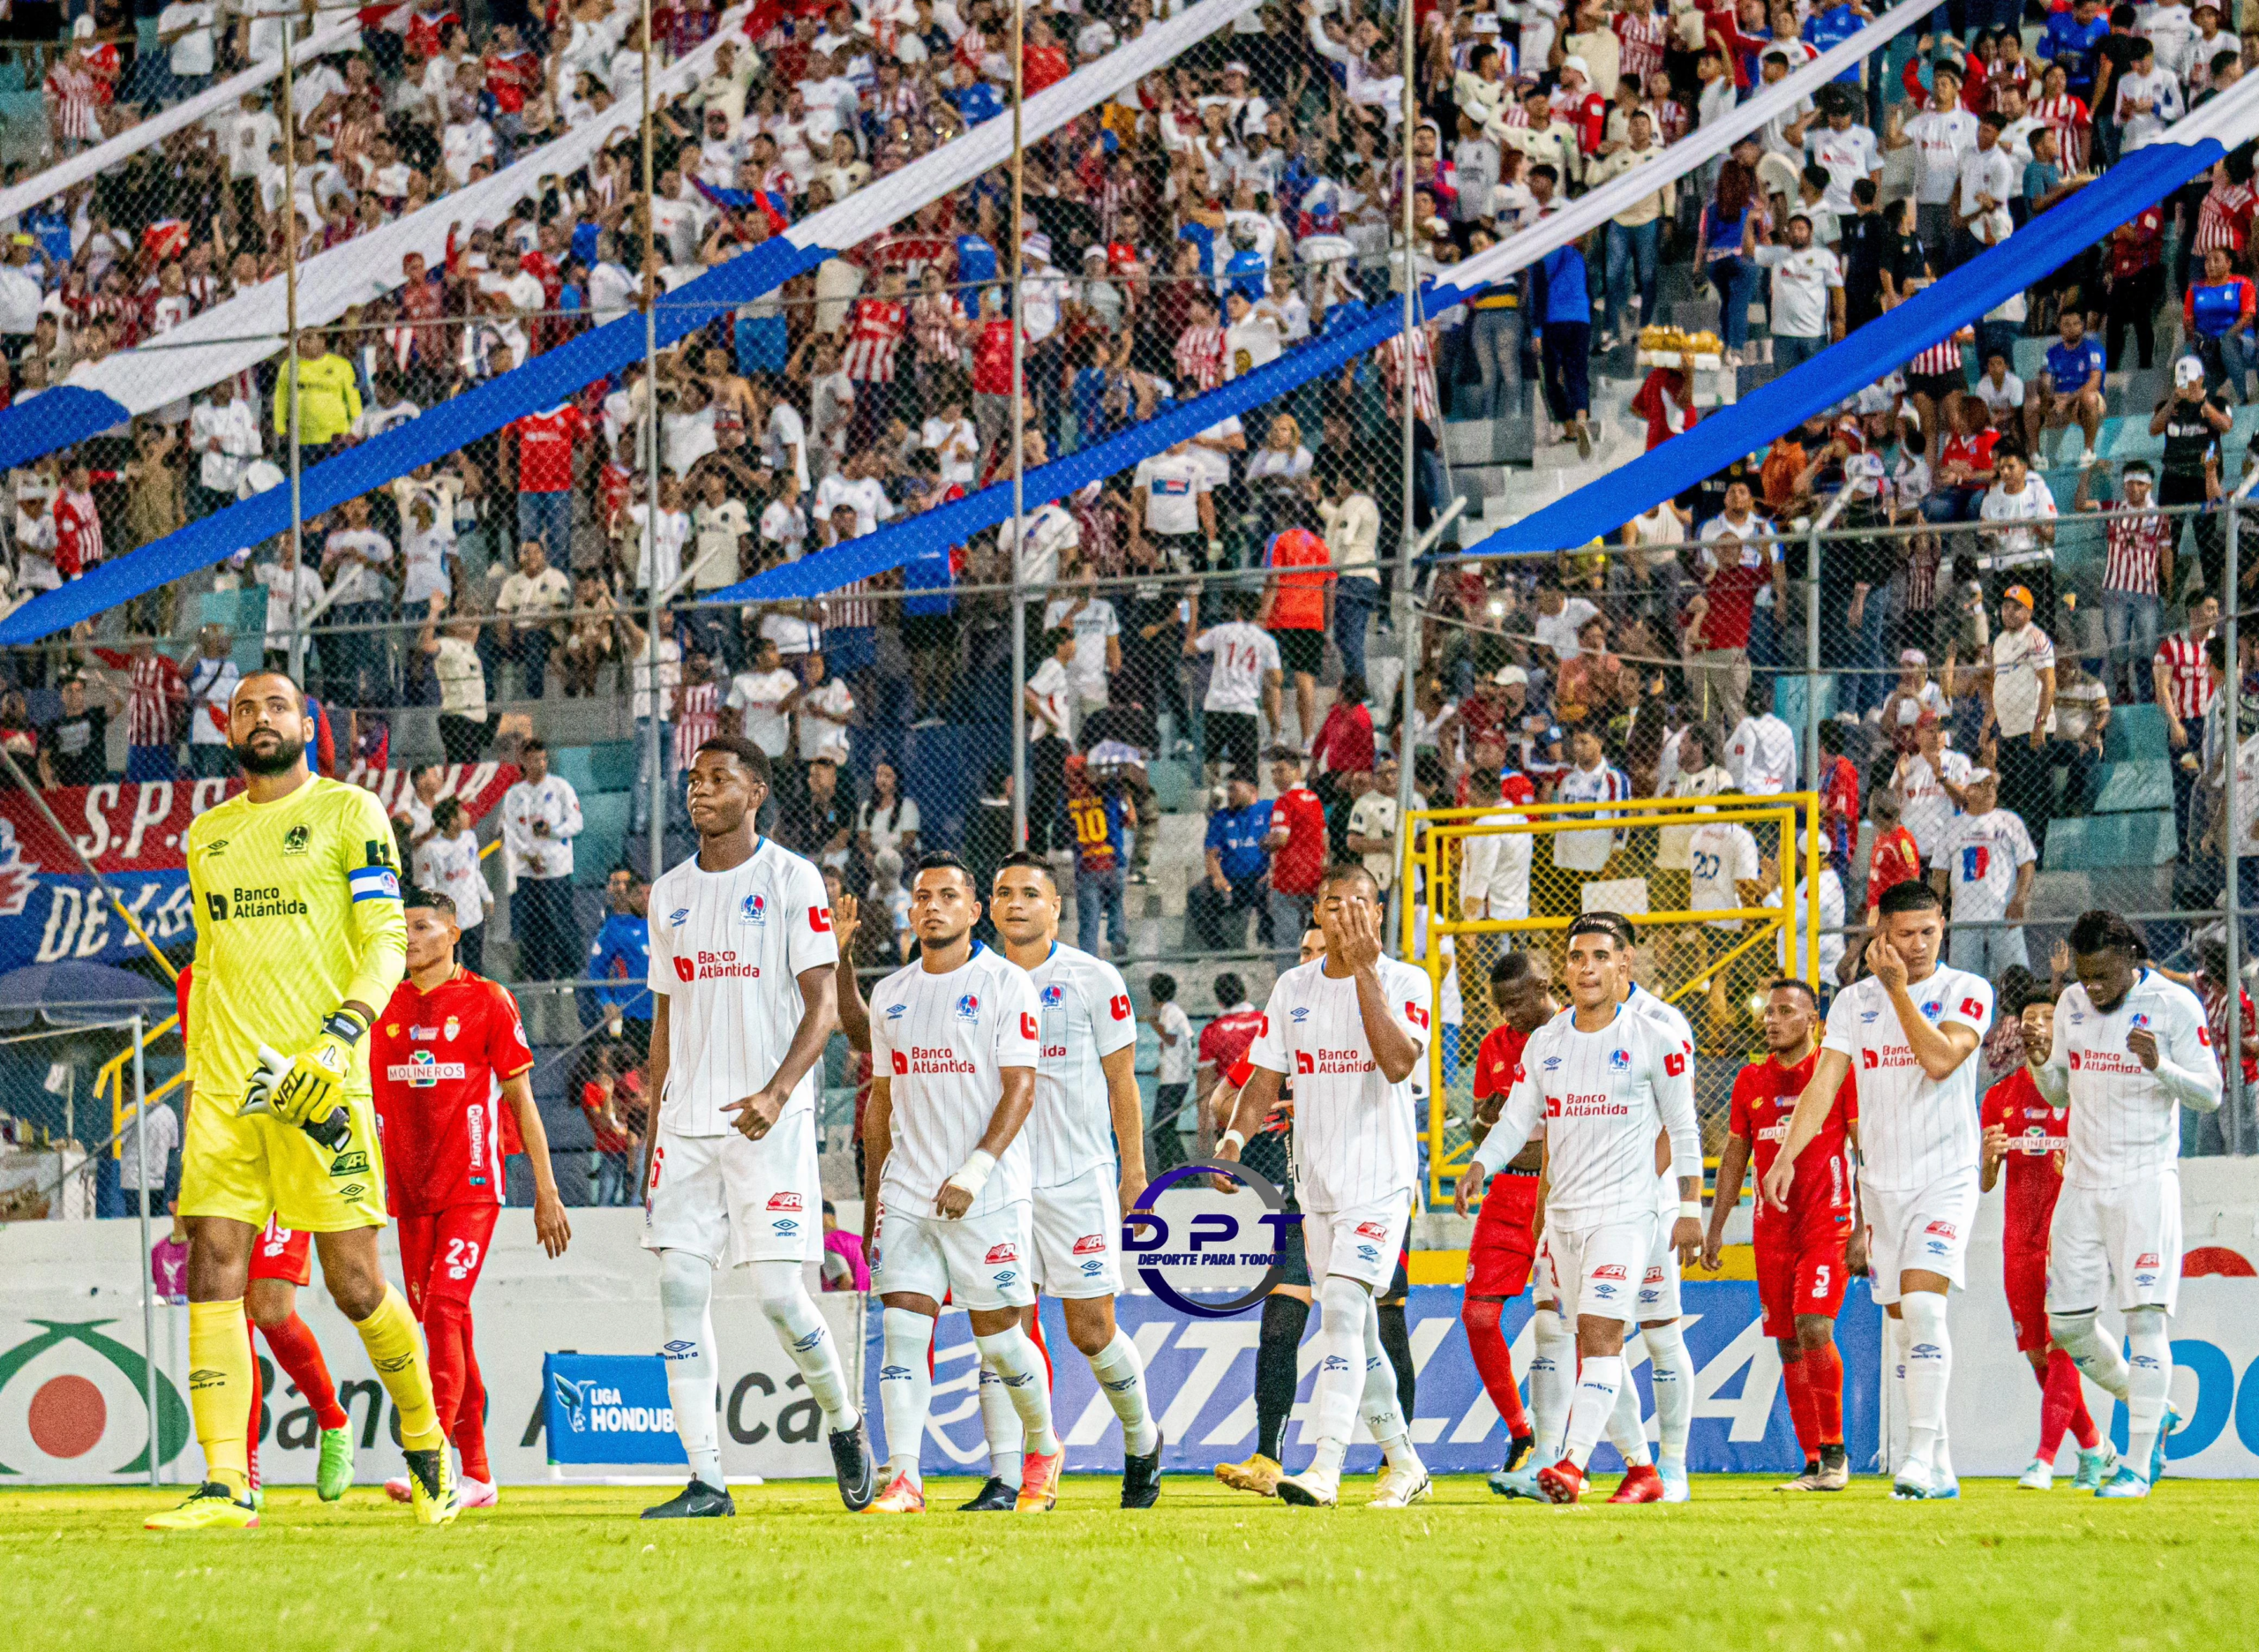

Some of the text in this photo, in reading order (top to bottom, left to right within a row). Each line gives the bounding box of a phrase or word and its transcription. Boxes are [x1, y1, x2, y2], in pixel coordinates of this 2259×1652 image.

[1070, 808, 1108, 845] 10
[234, 887, 280, 903] Banco
[234, 899, 308, 919] Atlántida
[35, 885, 111, 963] DE
[698, 963, 761, 980] Atlántida
[912, 1047, 953, 1060] Banco
[1318, 1048, 1359, 1061] Banco
[1882, 1045, 1911, 1055] Banc
[2083, 1048, 2121, 1062] Banco
[389, 1065, 463, 1079] MOLINEROS
[912, 1059, 976, 1074] Atlántida
[2083, 1061, 2142, 1075] Atlántida
[1565, 1093, 1607, 1105] Banco
[1565, 1104, 1628, 1117] Atlántida
[445, 1238, 479, 1269] 23
[1815, 1265, 1830, 1286] 5
[590, 1388, 622, 1405] LIGA
[590, 1408, 678, 1432] HONDUB
